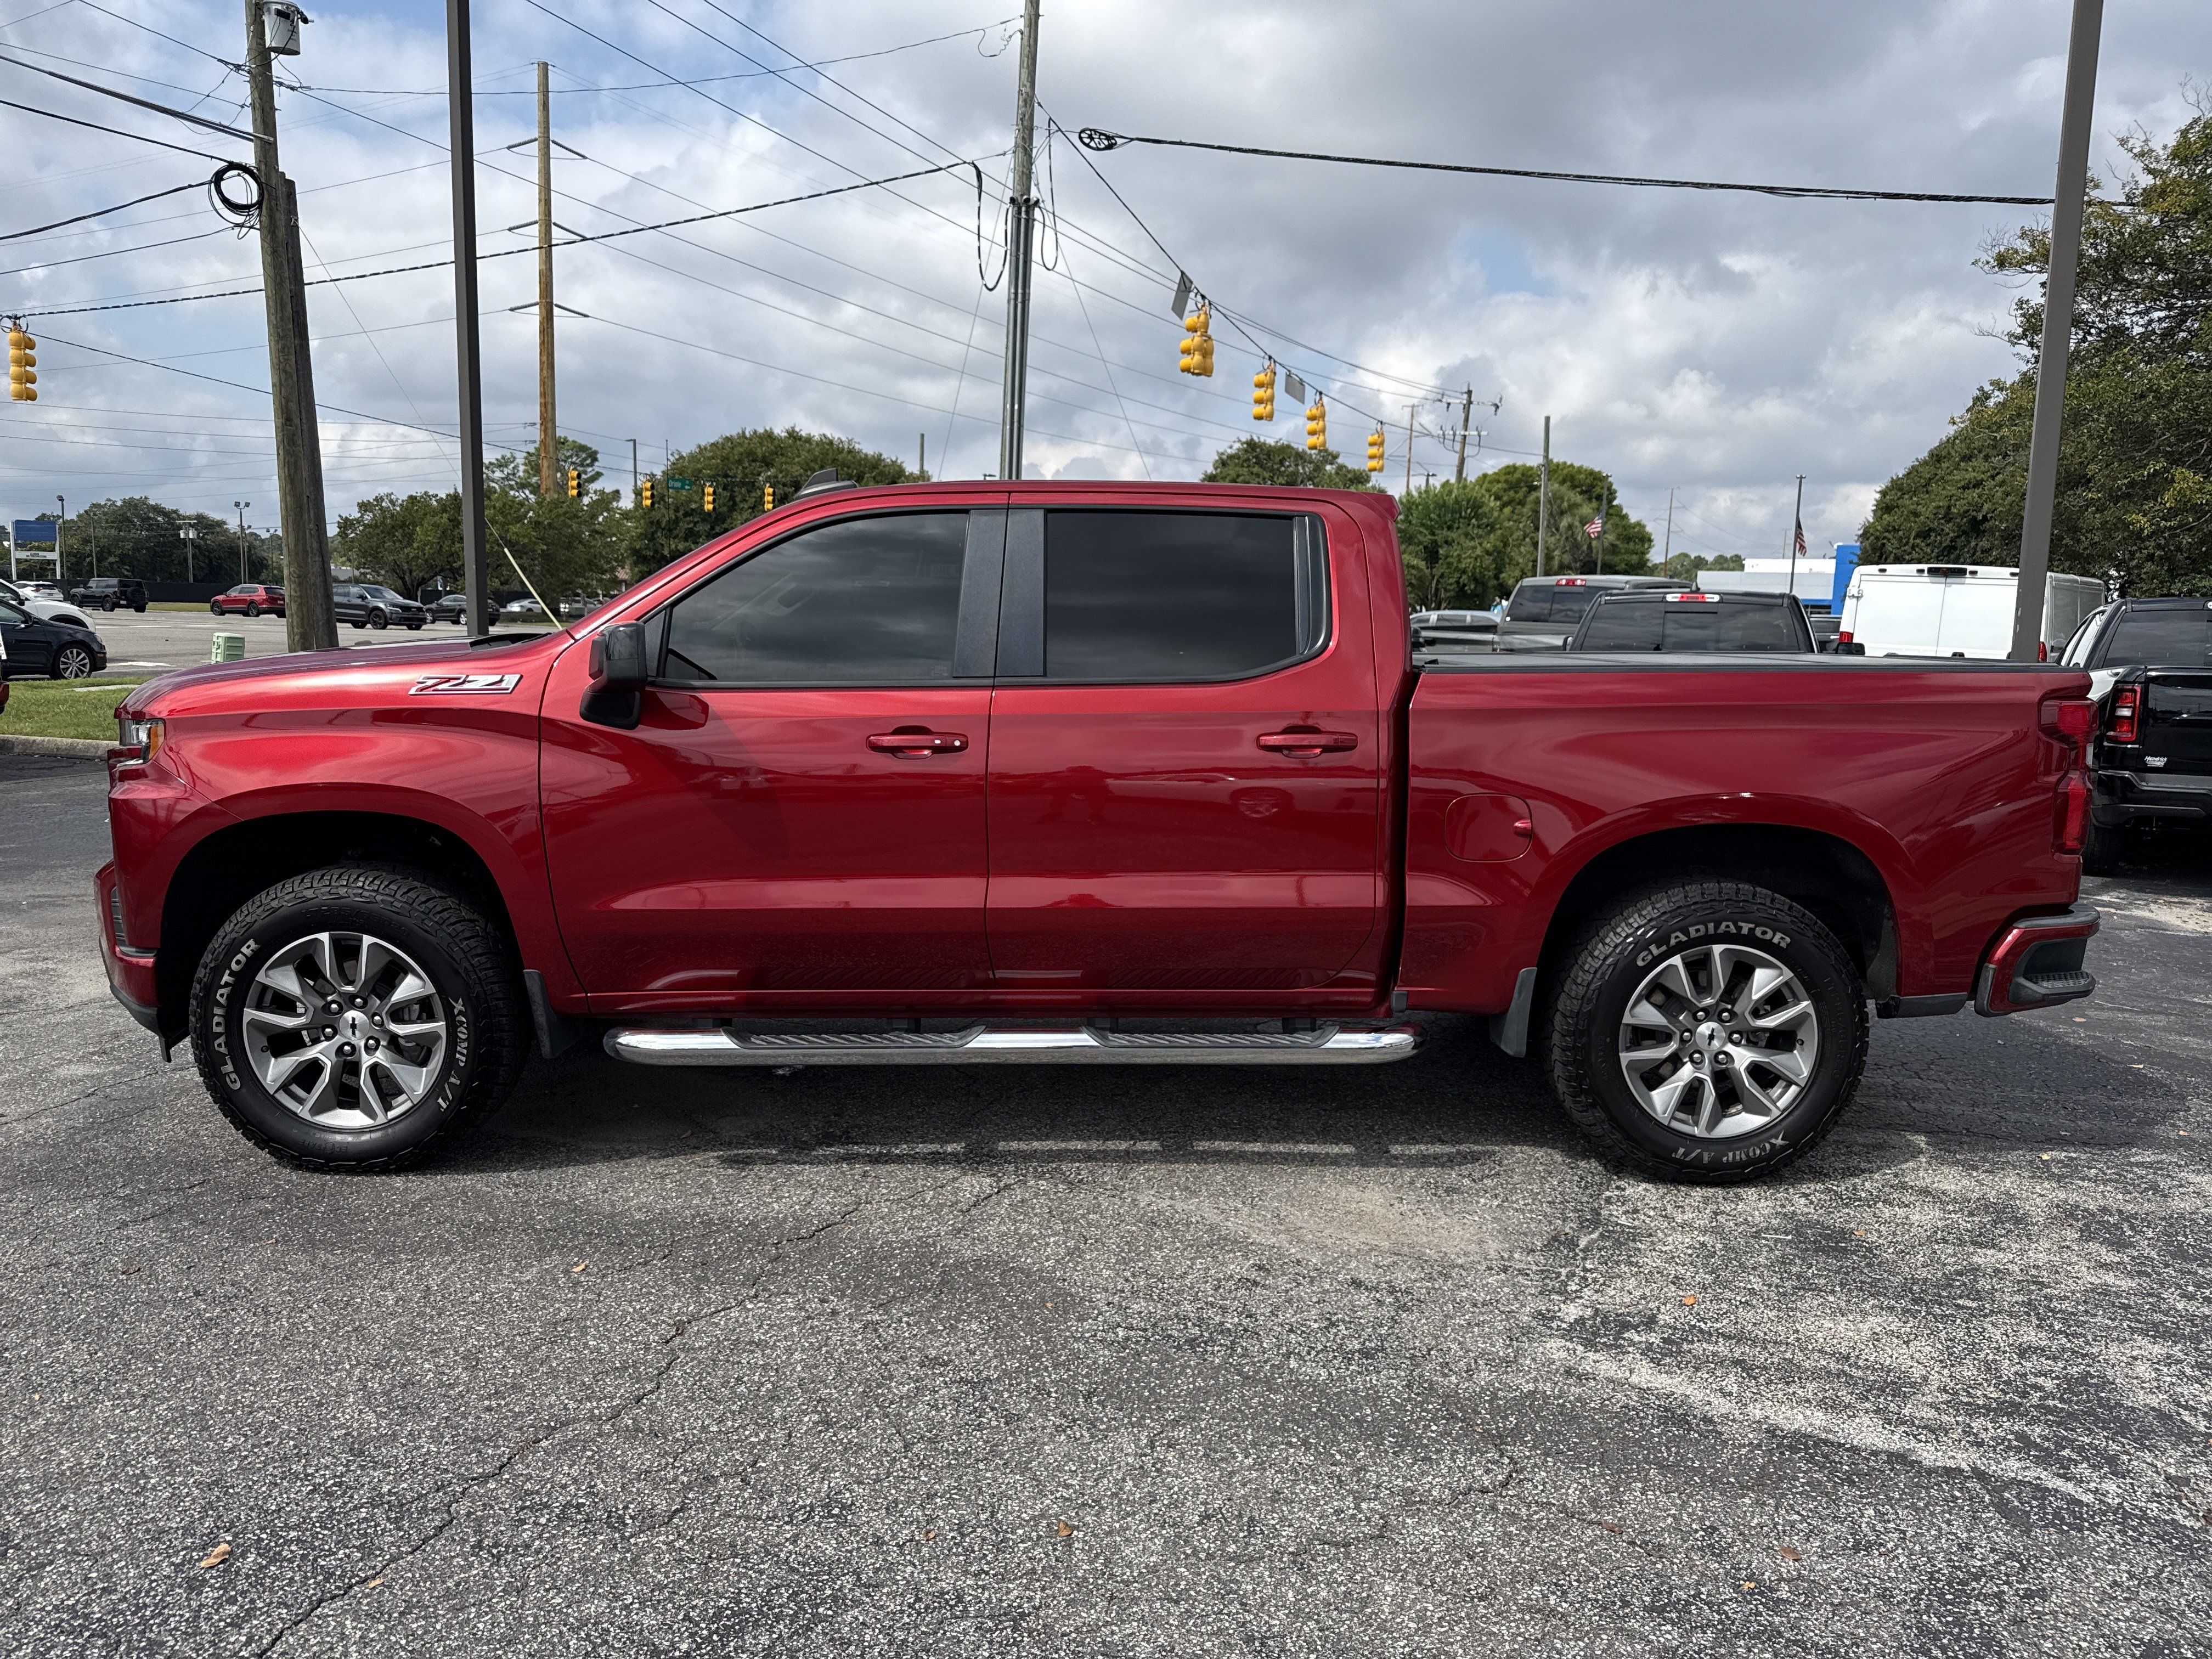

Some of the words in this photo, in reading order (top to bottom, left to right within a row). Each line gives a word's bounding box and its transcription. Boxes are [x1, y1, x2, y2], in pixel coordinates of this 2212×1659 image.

[408, 674, 523, 696] Z71
[1636, 922, 1791, 967] GLADIATOR
[212, 938, 261, 1090] GLADIATOR
[437, 1070, 461, 1112] A/T
[1672, 1147, 1715, 1164] A/T
